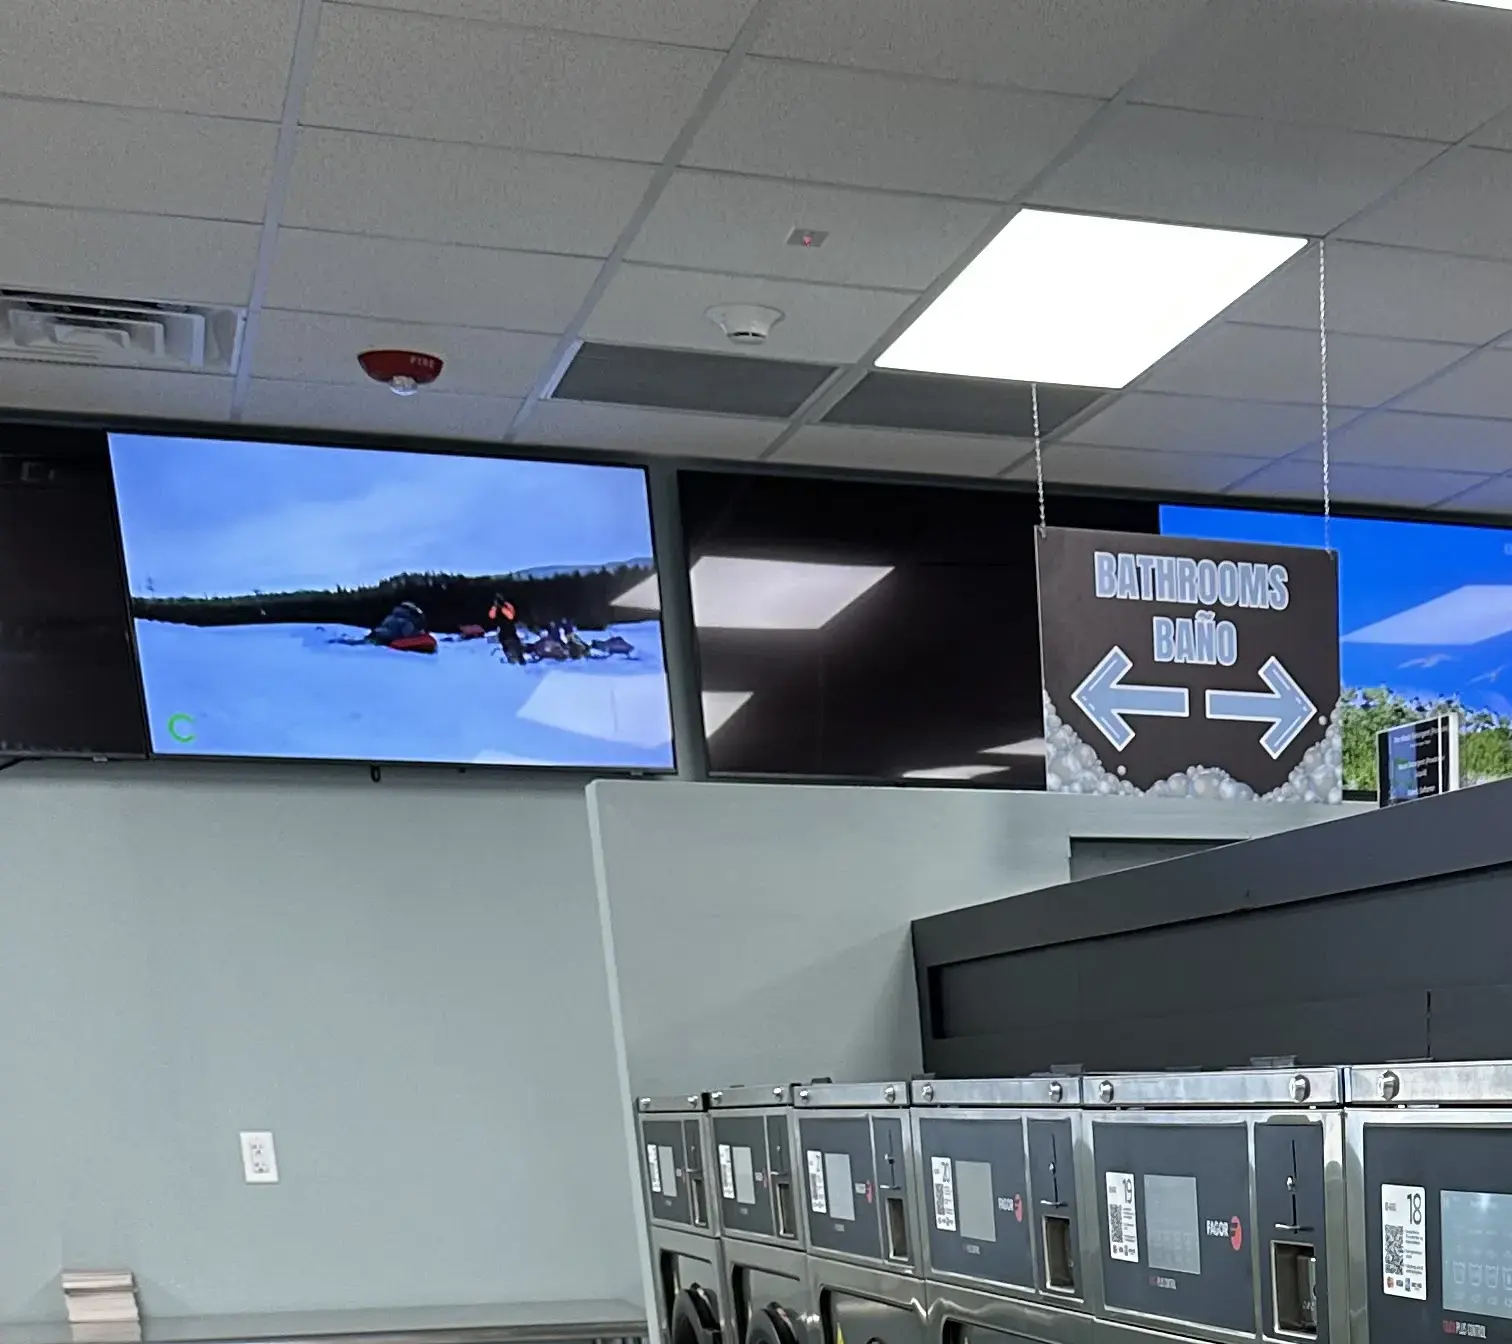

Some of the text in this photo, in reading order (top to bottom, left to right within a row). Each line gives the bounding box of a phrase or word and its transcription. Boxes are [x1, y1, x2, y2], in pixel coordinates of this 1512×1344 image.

[1093, 550, 1290, 611] BATHROOMS
[1153, 610, 1239, 667] BAÑO
[1205, 1219, 1230, 1238] FAGOR
[1406, 1193, 1422, 1225] 18
